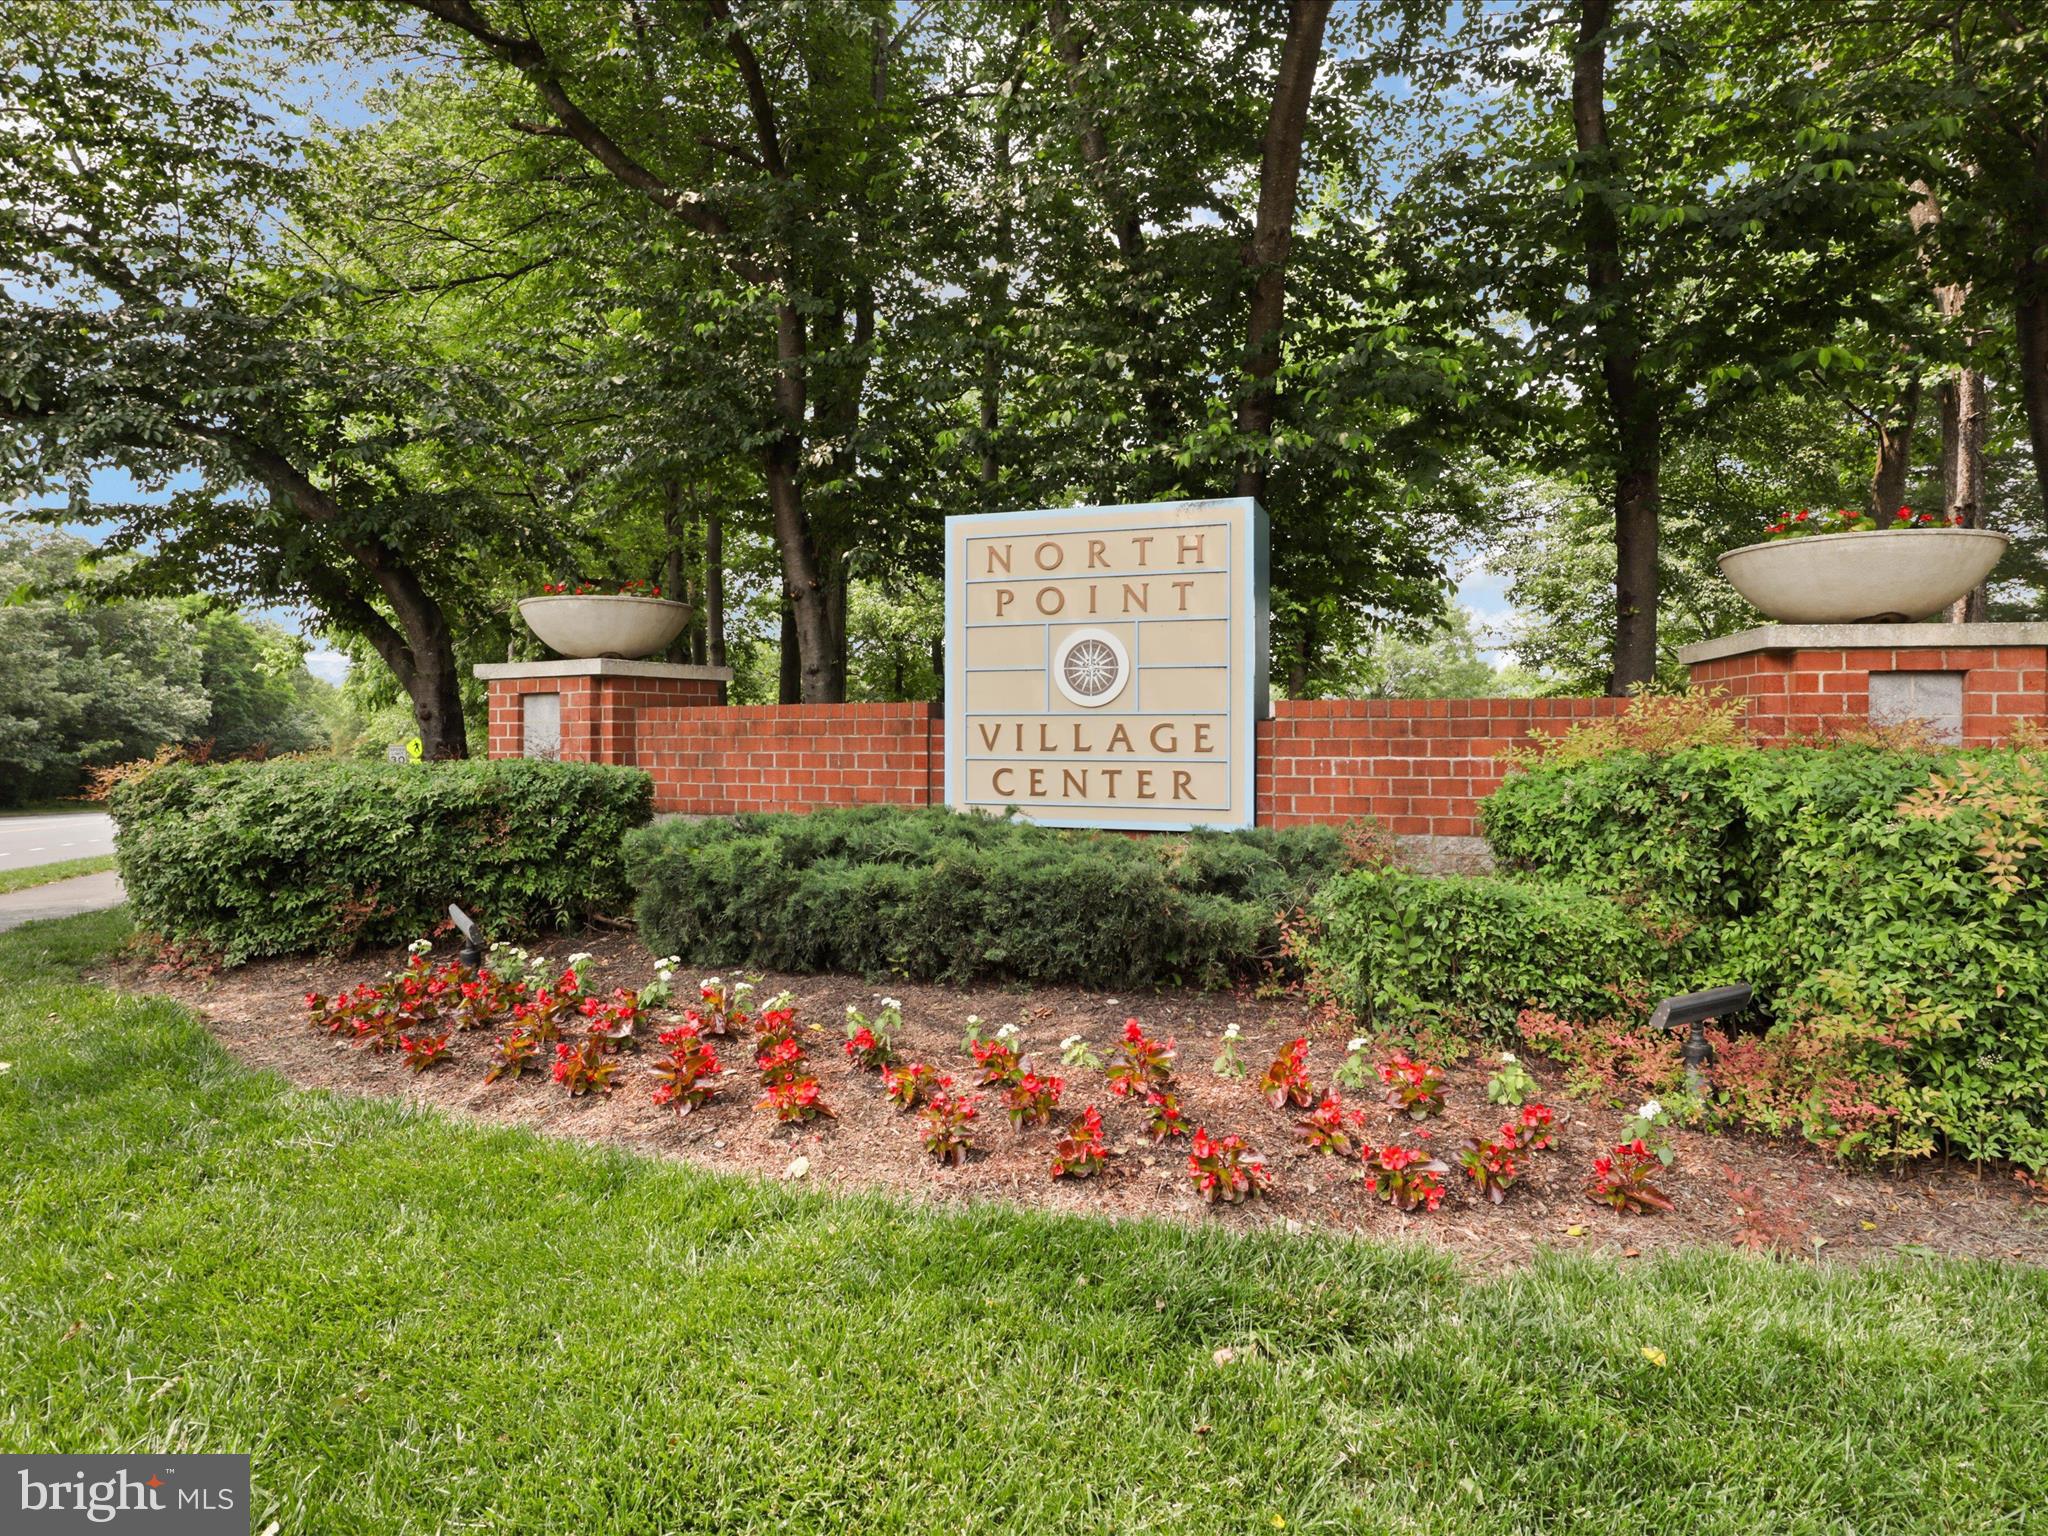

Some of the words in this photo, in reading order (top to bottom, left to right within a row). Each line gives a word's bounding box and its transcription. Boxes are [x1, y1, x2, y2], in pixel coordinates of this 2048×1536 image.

[986, 533, 1205, 574] NORTH
[995, 581, 1195, 617] POINT
[978, 722, 1215, 753] VILLAGE
[992, 767, 1198, 800] CENTER
